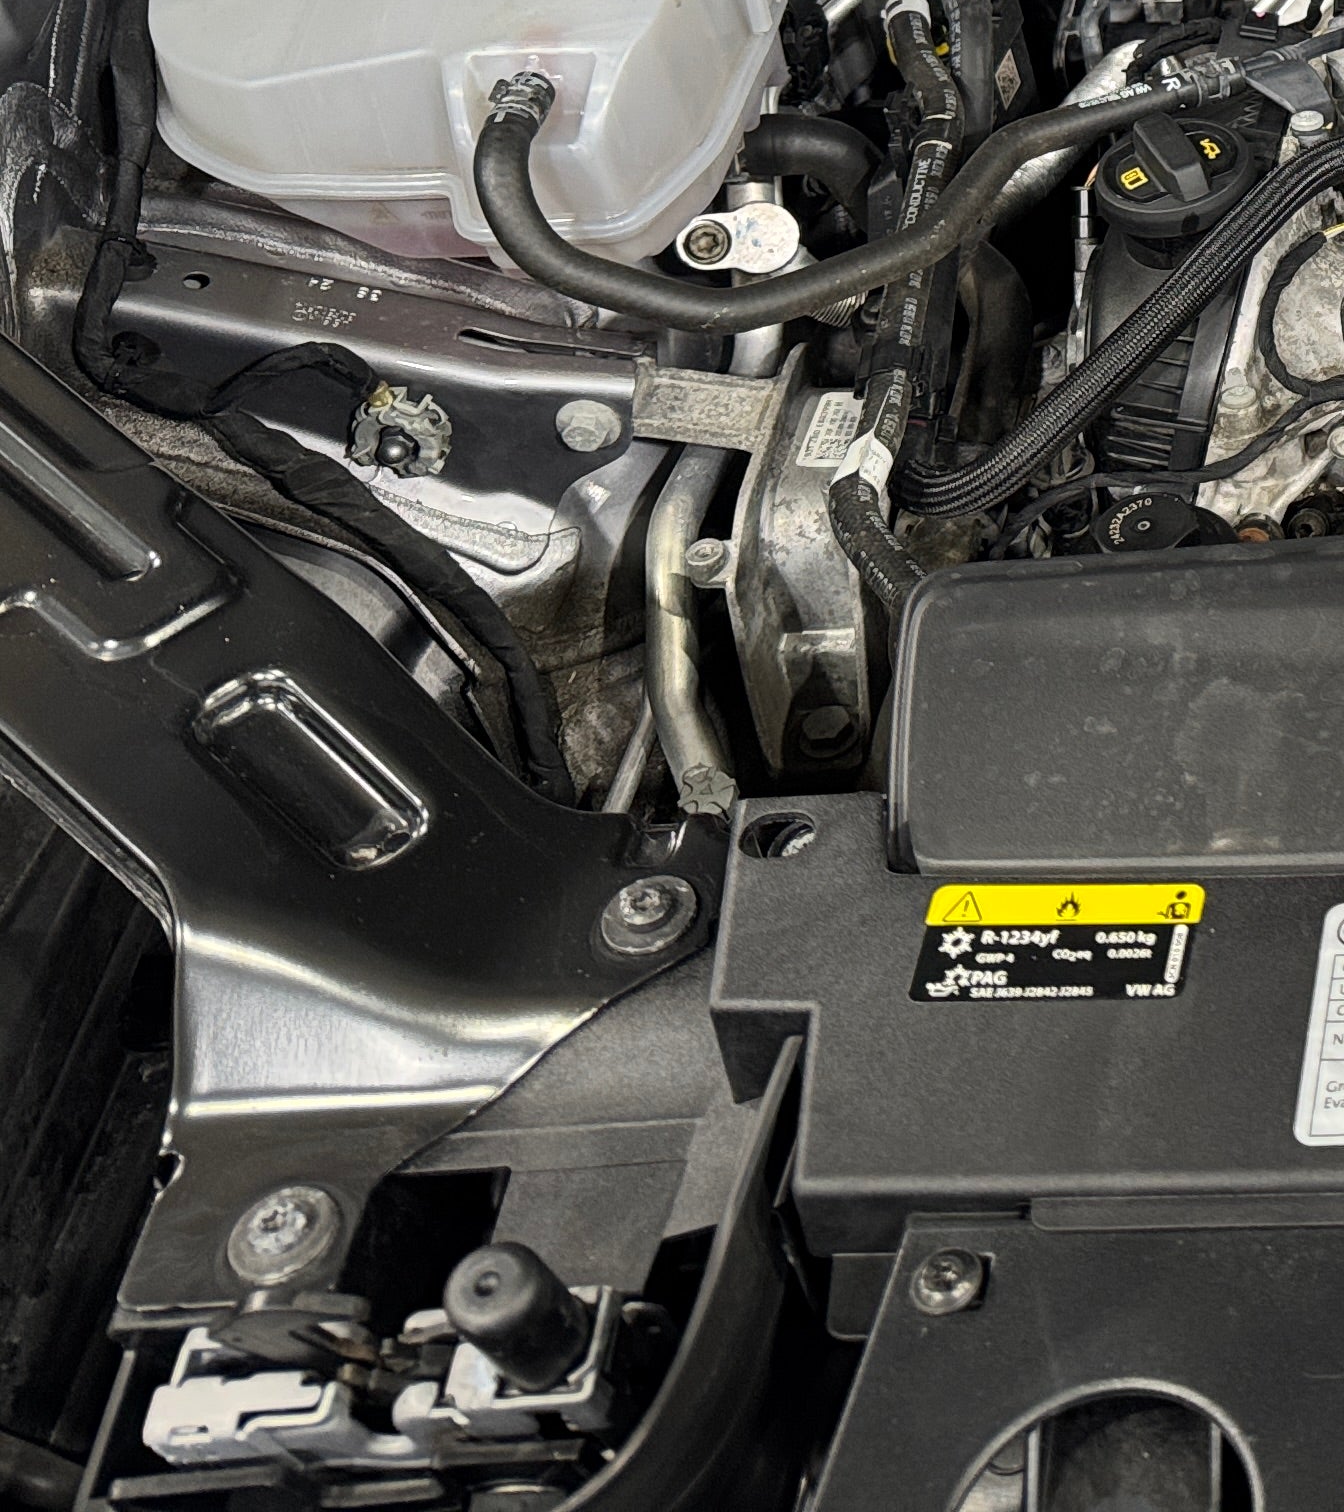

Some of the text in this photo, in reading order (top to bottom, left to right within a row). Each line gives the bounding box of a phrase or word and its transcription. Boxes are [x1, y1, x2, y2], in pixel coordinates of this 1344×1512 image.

[980, 929, 1158, 948] R-1234yf 0.650 kg
[971, 970, 1008, 986] PAG
[969, 987, 994, 998] SAE
[1125, 984, 1152, 997] VW
[1152, 984, 1176, 997] AG
